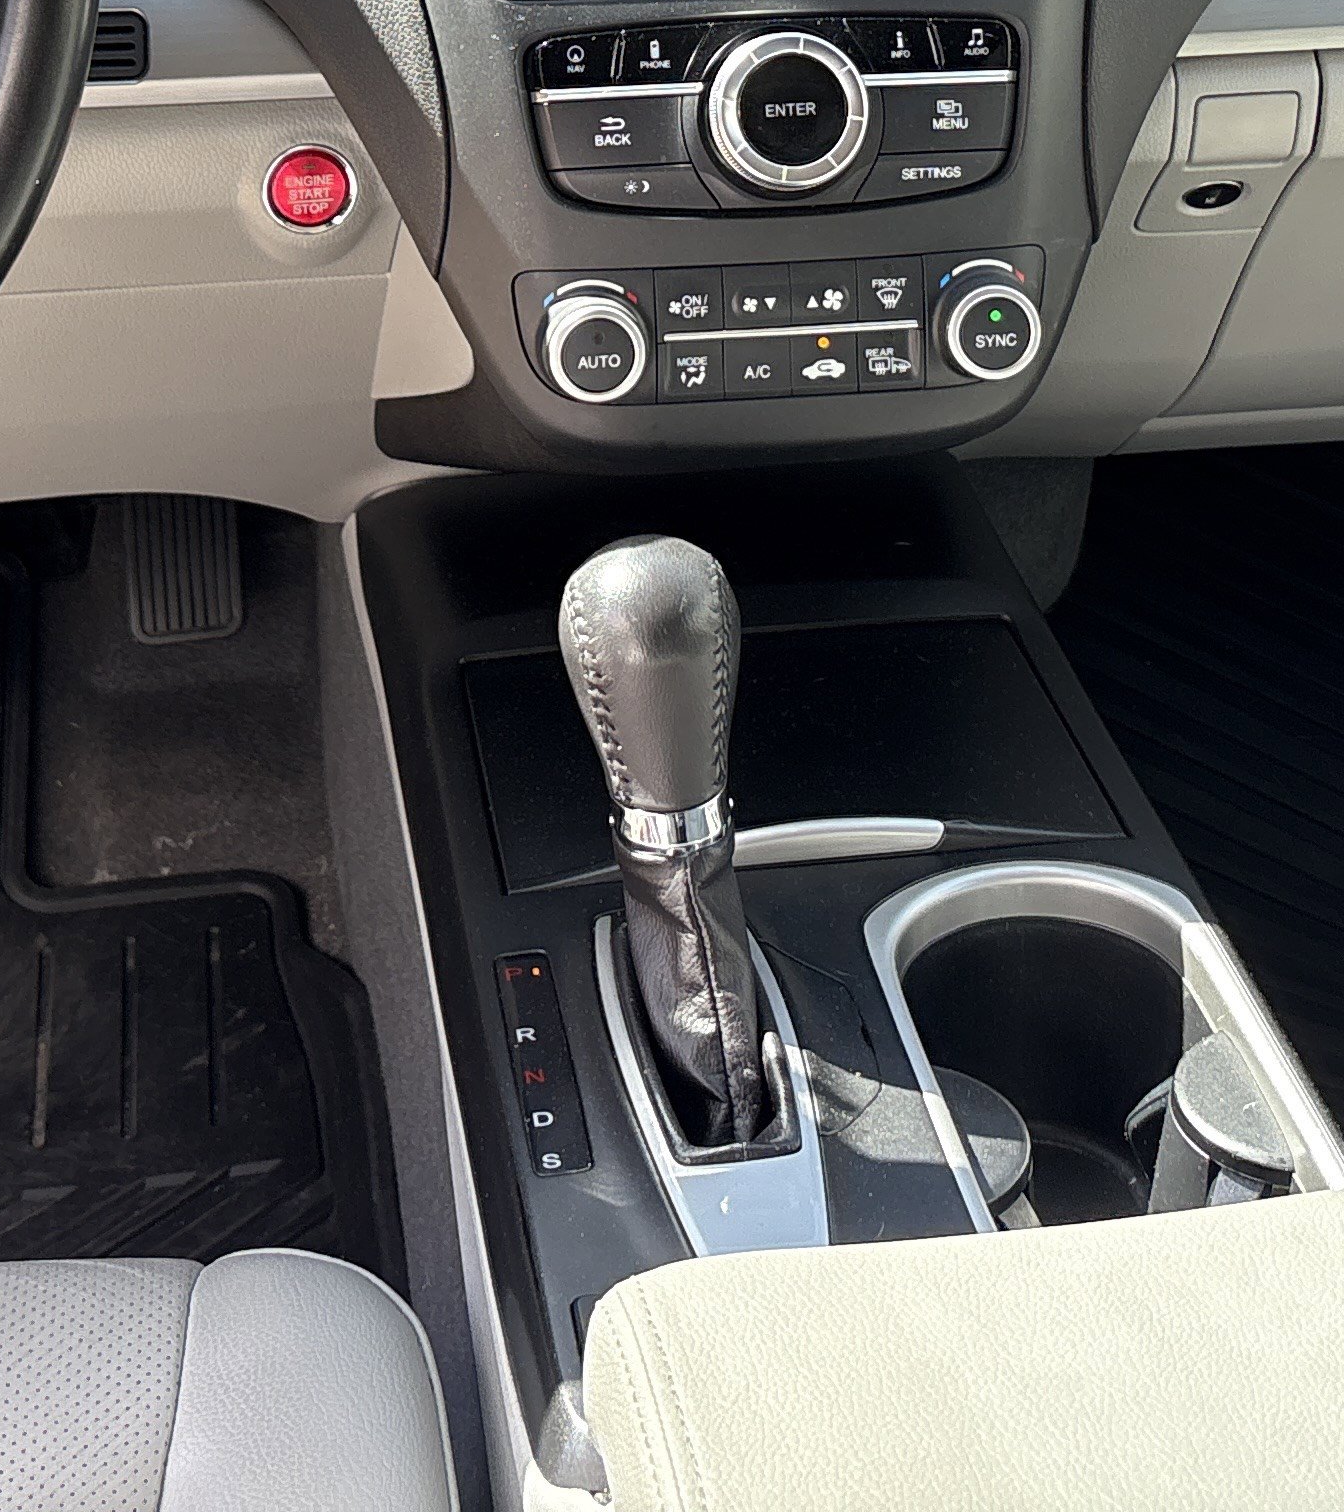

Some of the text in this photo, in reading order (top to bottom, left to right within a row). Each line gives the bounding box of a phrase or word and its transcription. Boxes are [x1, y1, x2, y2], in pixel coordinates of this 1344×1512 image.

[891, 49, 911, 59] INFO
[964, 47, 989, 57] AUDIO
[566, 64, 586, 74] NAV
[640, 60, 671, 70] PHONE
[765, 102, 817, 118] ENTER
[932, 117, 968, 130] MENU
[594, 133, 632, 147] BACK
[901, 166, 962, 181] SETTINGS
[284, 174, 334, 188] ENGINE
[288, 188, 330, 201] START
[292, 203, 329, 215] STOP
[871, 277, 907, 288] FRONT
[681, 305, 709, 319] OFF
[975, 333, 1017, 349] SYNC
[865, 347, 894, 358] REAR
[578, 354, 622, 370] AUTO
[676, 355, 709, 367] MODE
[744, 365, 771, 380] A/C
[503, 967, 523, 981] P
[515, 1027, 537, 1042] R
[524, 1069, 546, 1084] N
[532, 1111, 554, 1127] D
[541, 1153, 562, 1169] S
